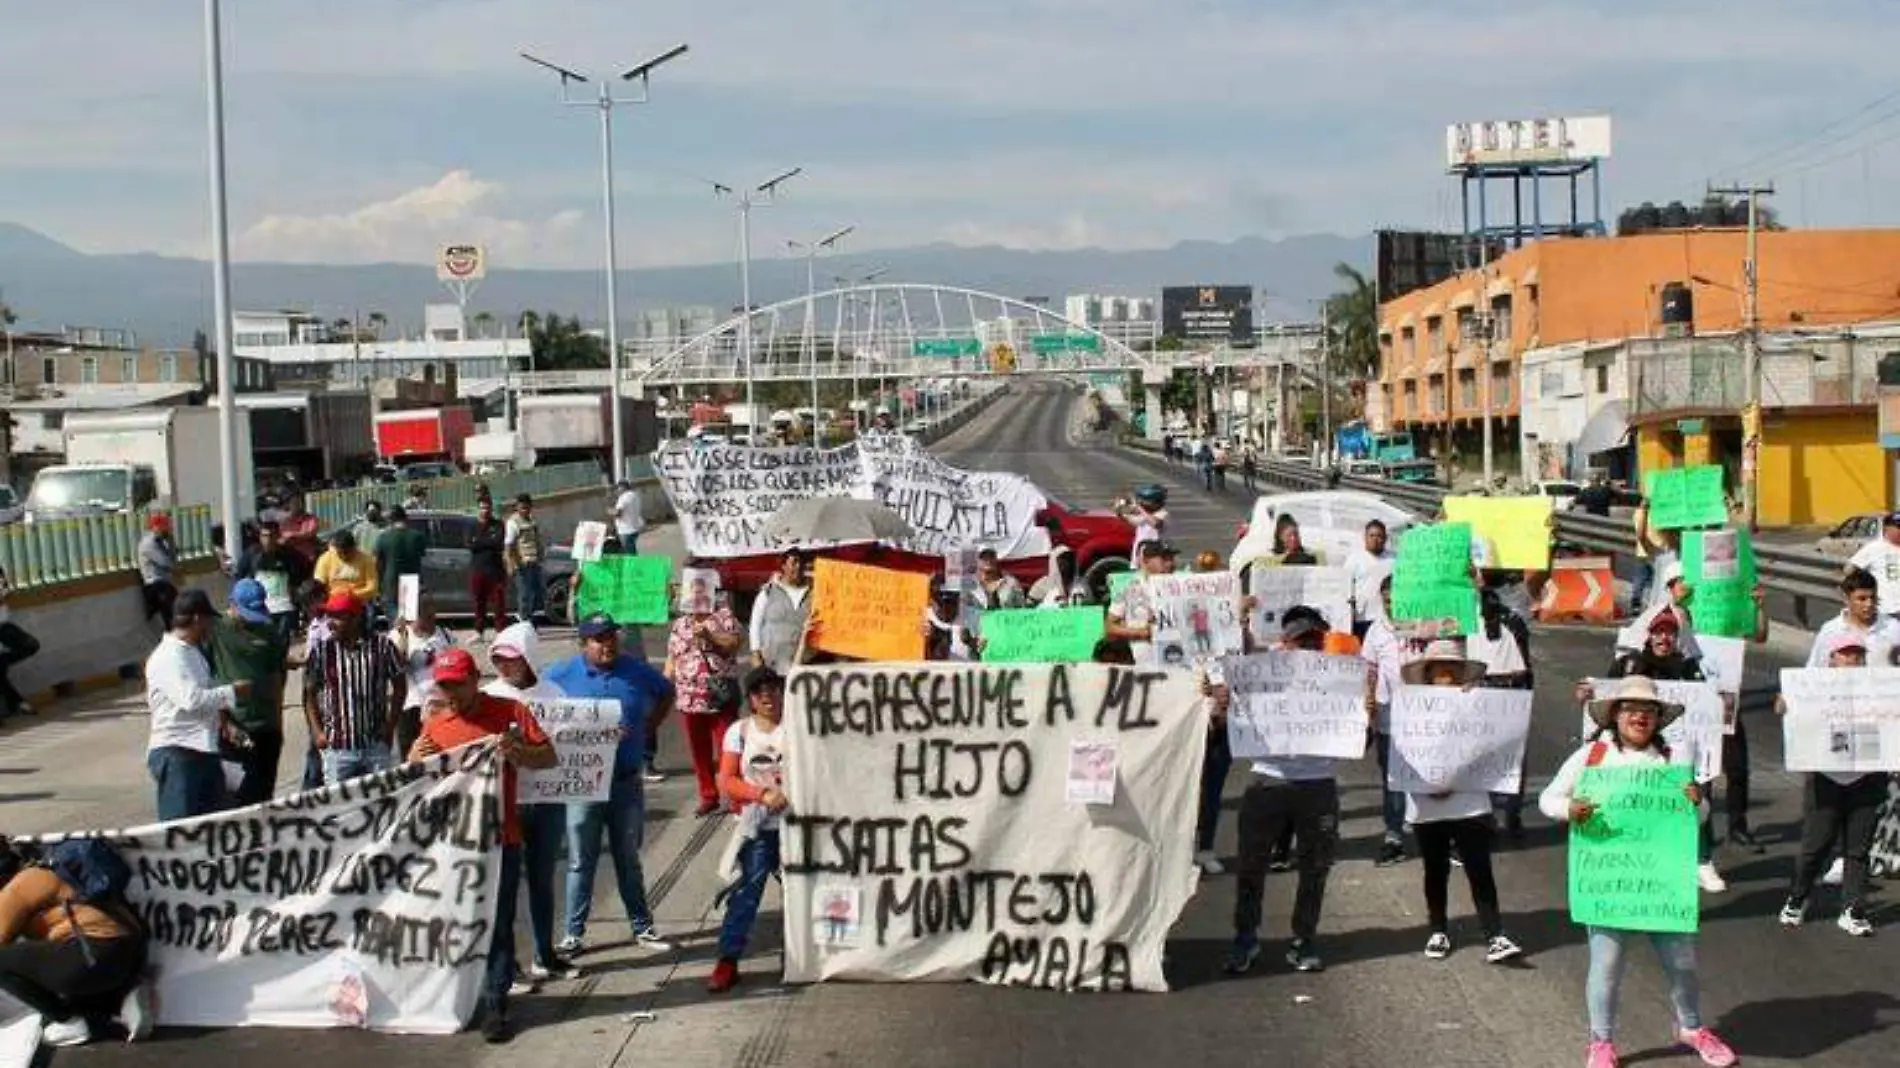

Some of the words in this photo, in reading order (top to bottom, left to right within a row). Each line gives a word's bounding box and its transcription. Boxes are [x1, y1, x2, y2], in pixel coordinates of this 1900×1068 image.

[1046, 664, 1075, 725] A
[1095, 667, 1168, 731] MI
[893, 739, 1032, 800] HIJO
[784, 813, 971, 874] ISAIAS
[242, 906, 346, 956] PEREZ
[876, 870, 1095, 946] MONTEJO
[982, 931, 1133, 992] AYALA
